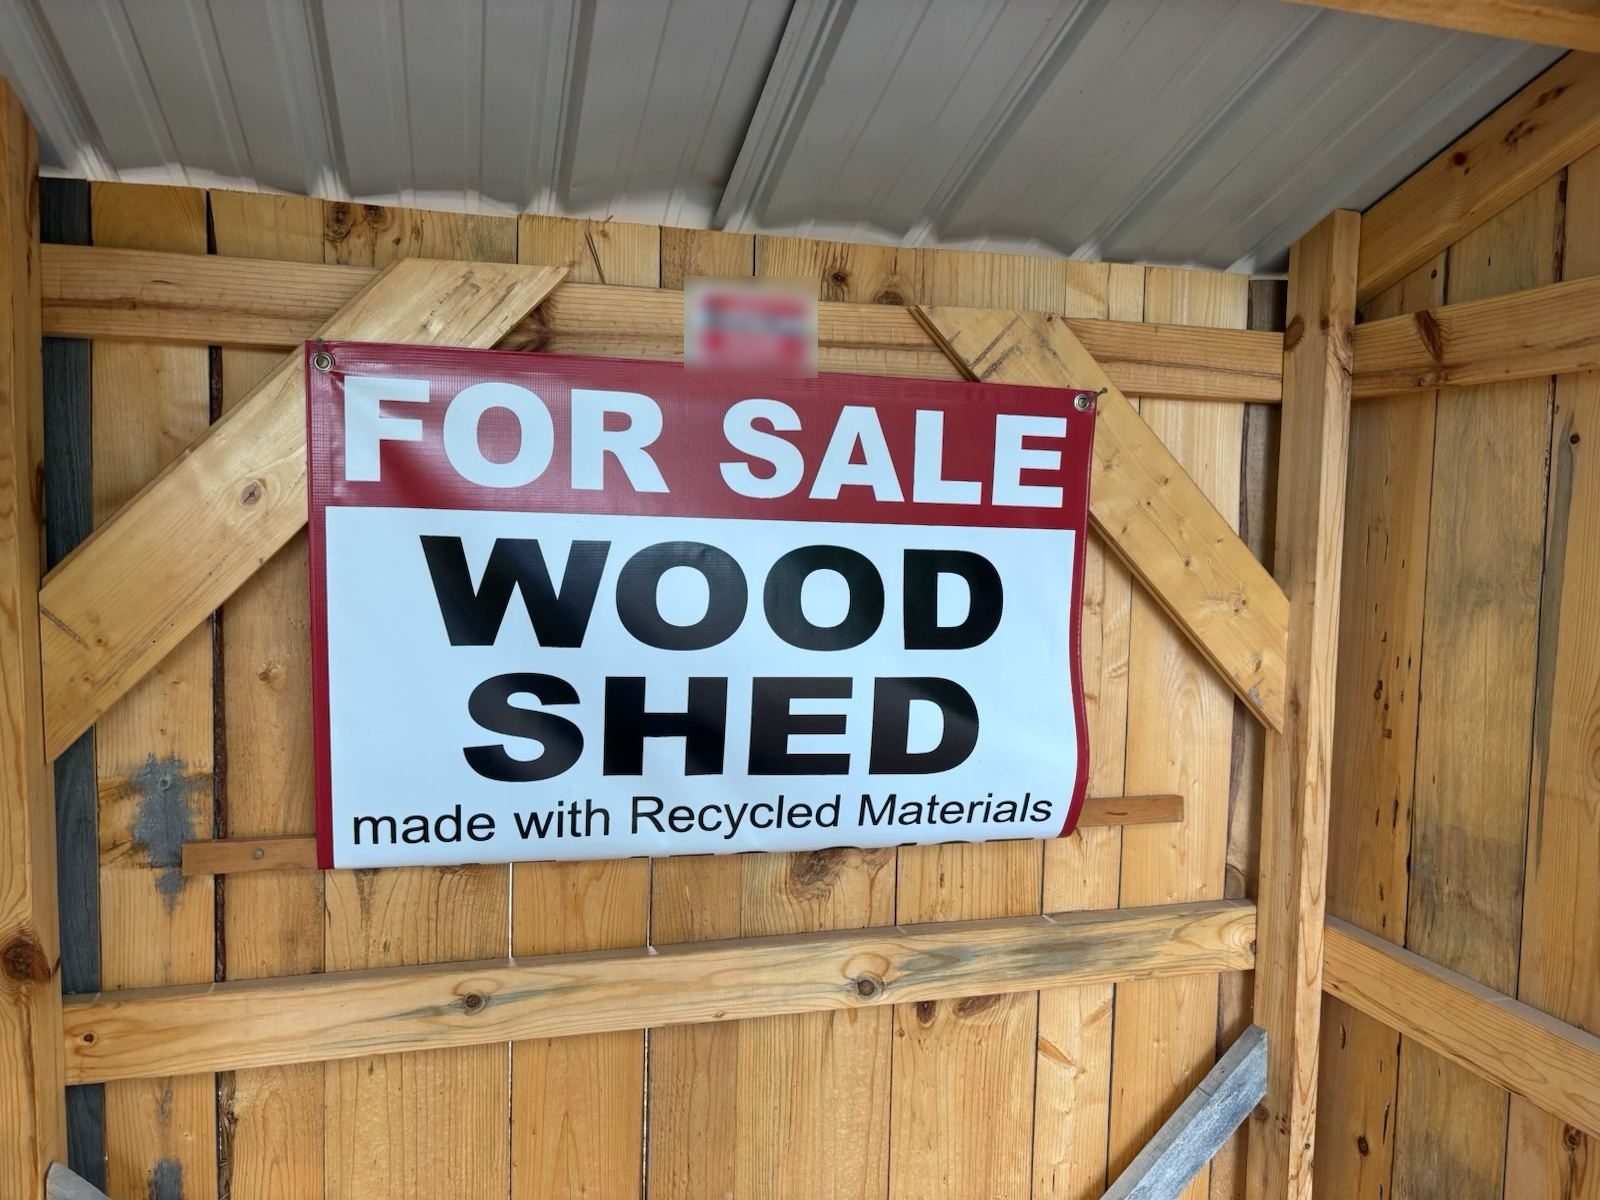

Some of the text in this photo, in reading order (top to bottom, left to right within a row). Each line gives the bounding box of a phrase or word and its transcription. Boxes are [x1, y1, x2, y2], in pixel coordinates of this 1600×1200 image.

[344, 377, 1067, 507] FOR SALE
[420, 535, 1004, 651] WOOD
[463, 672, 979, 782] SHED
[353, 793, 1052, 845] made with Recycled Materials
